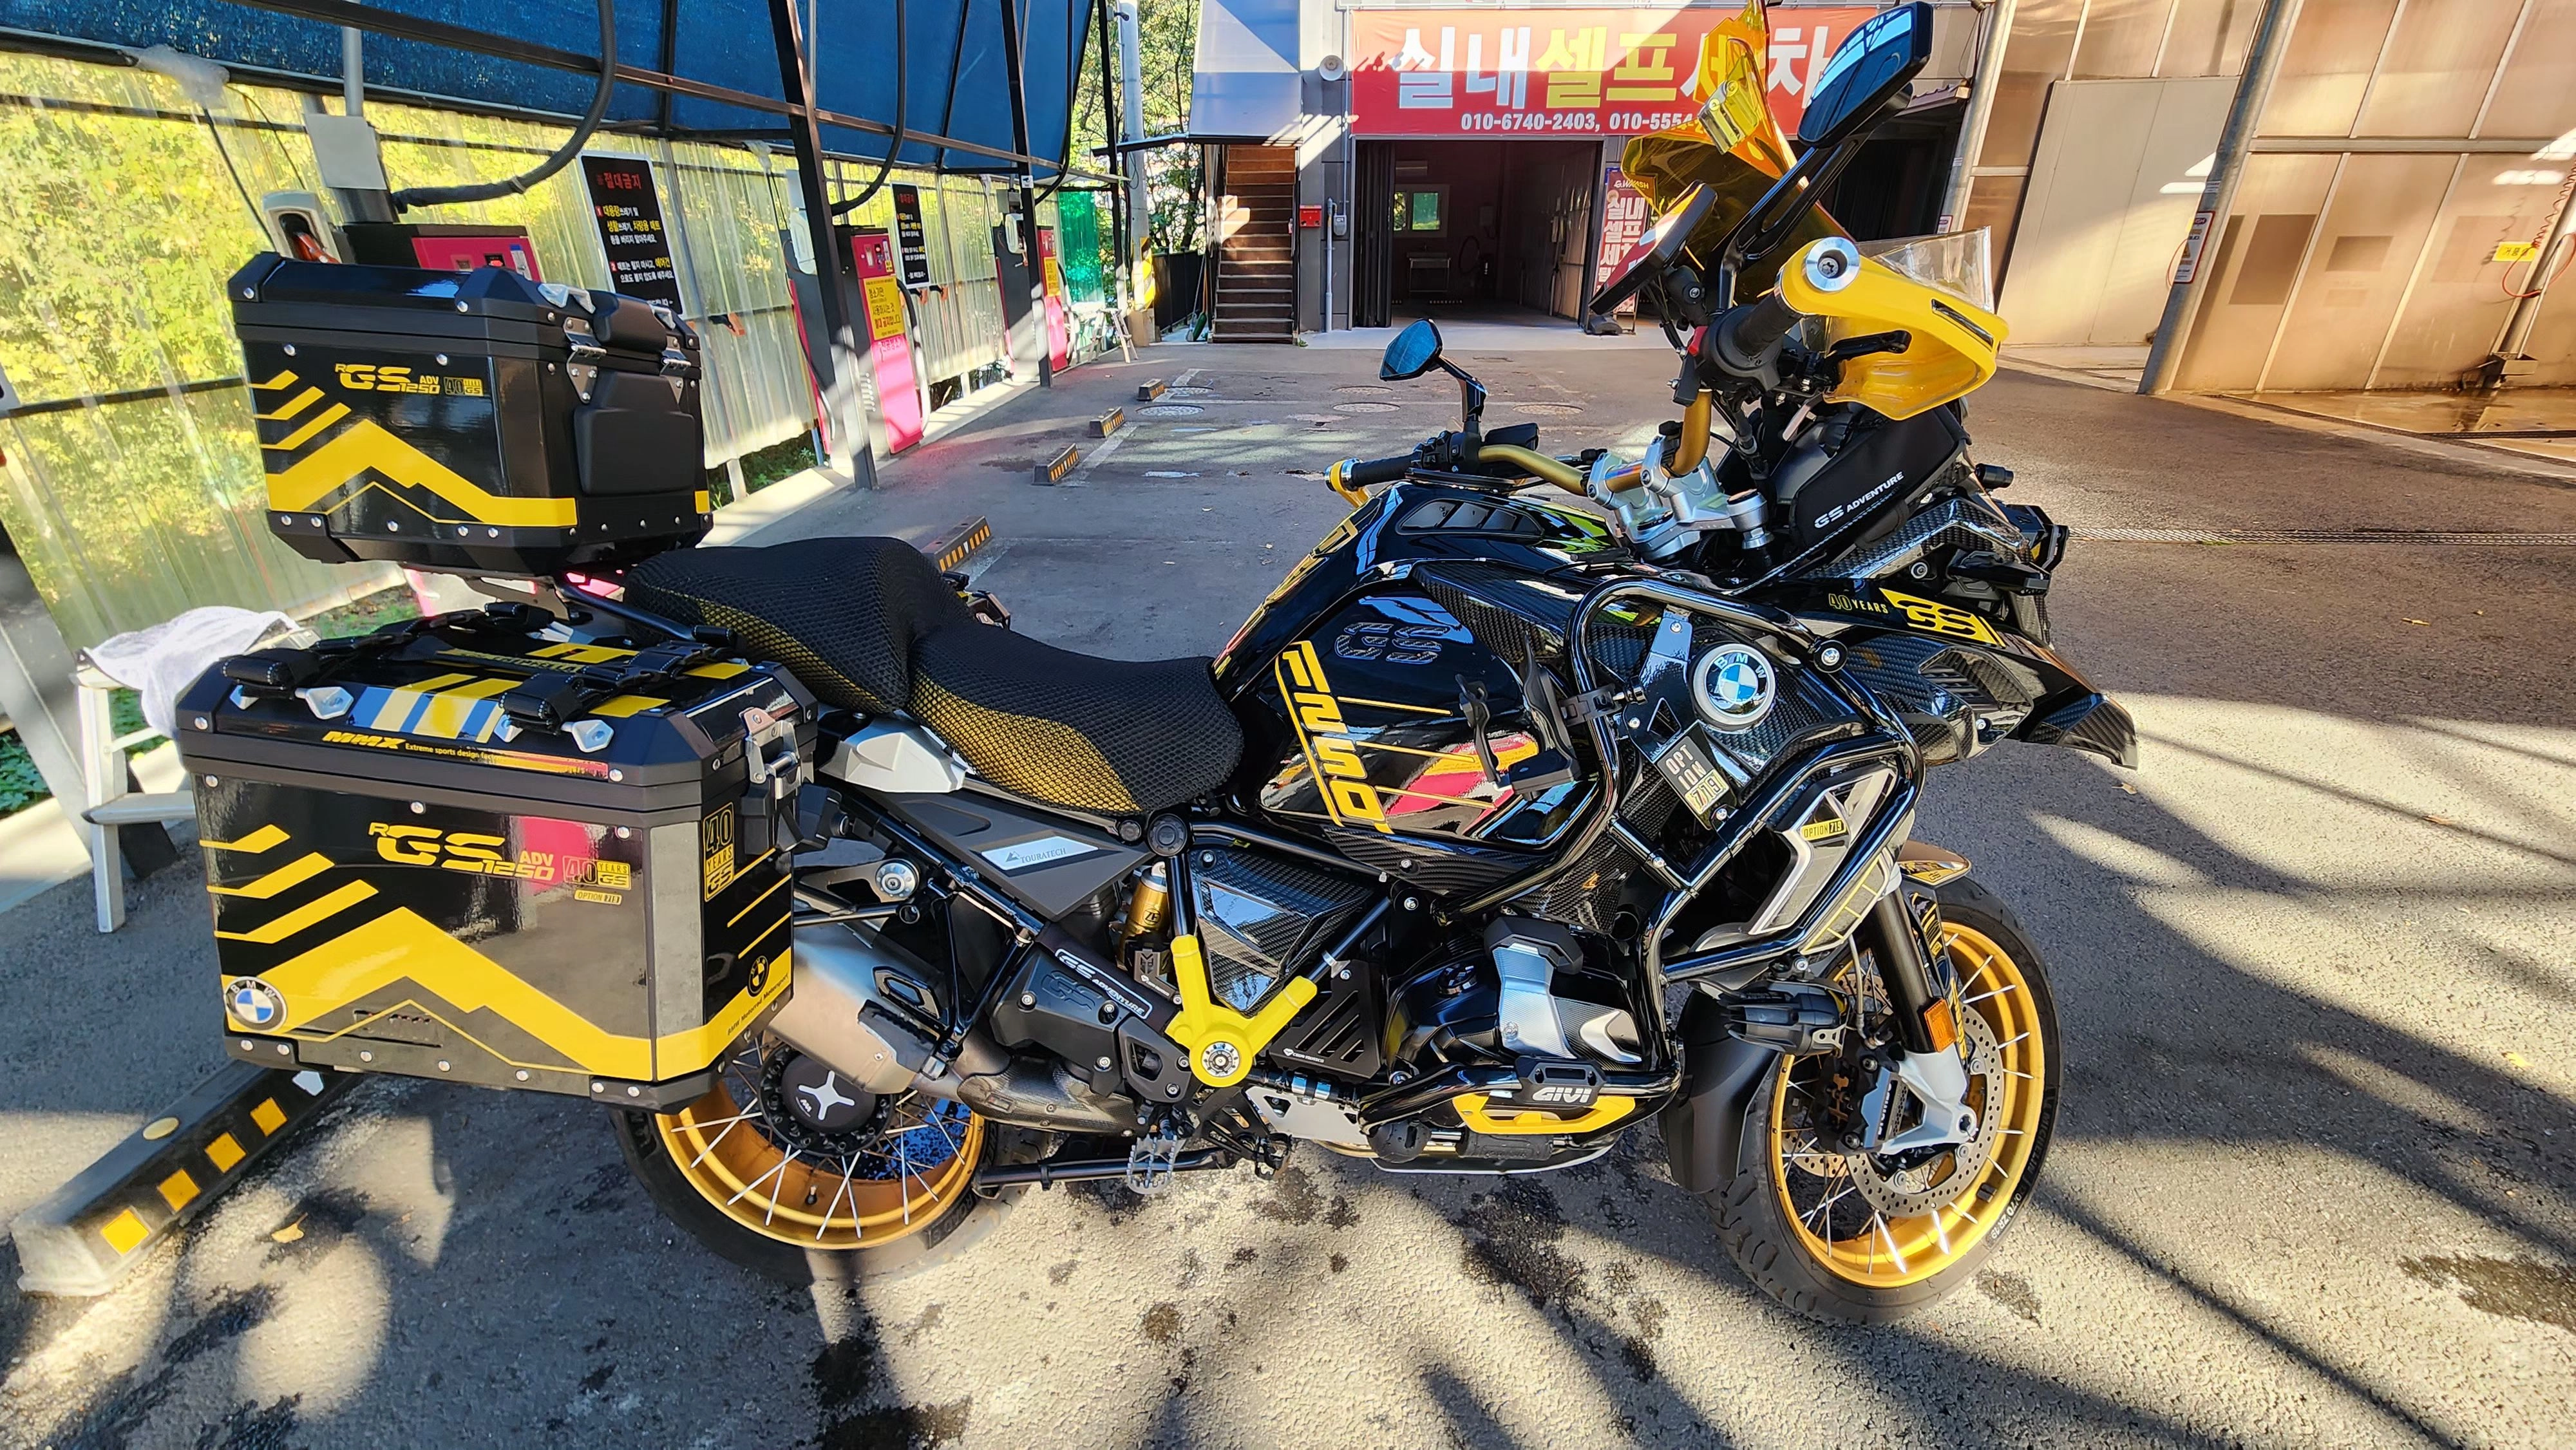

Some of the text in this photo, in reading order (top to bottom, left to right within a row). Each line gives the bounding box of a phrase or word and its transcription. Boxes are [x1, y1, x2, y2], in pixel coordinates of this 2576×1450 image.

[1461, 113, 1600, 132] 010-6740-2403,
[1607, 197, 1645, 220] 실내
[1604, 220, 1642, 243] 셀프
[335, 363, 412, 392] R GS
[399, 382, 440, 395] 1250
[419, 375, 439, 385] ADV
[1814, 471, 1904, 529] GS ADVENTURE
[1828, 593, 1888, 614] 40 YEARS
[1334, 622, 1451, 664] GS
[1714, 653, 1766, 679] BMW
[322, 731, 406, 750] MMX
[405, 743, 433, 753] Extreme
[435, 748, 456, 756] sports
[457, 749, 480, 759] design
[1665, 744, 1694, 775] OPT
[706, 809, 733, 854] 40
[1804, 820, 1842, 838] OPTION 719
[368, 822, 505, 872] R GS
[708, 845, 733, 872] YEARS
[1020, 847, 1067, 863] TOURATECH
[482, 859, 555, 881] 1250
[519, 851, 554, 867] ADV
[566, 858, 627, 884] 40 YEARS
[600, 874, 627, 885] GS
[578, 891, 603, 901] OPTION
[230, 980, 276, 998] BMW
[741, 996, 763, 1022] Motorrad
[763, 972, 788, 1000] Motorsport
[1092, 978, 1145, 1015] ADVENTURE
[1532, 1086, 1593, 1103] GIVI
